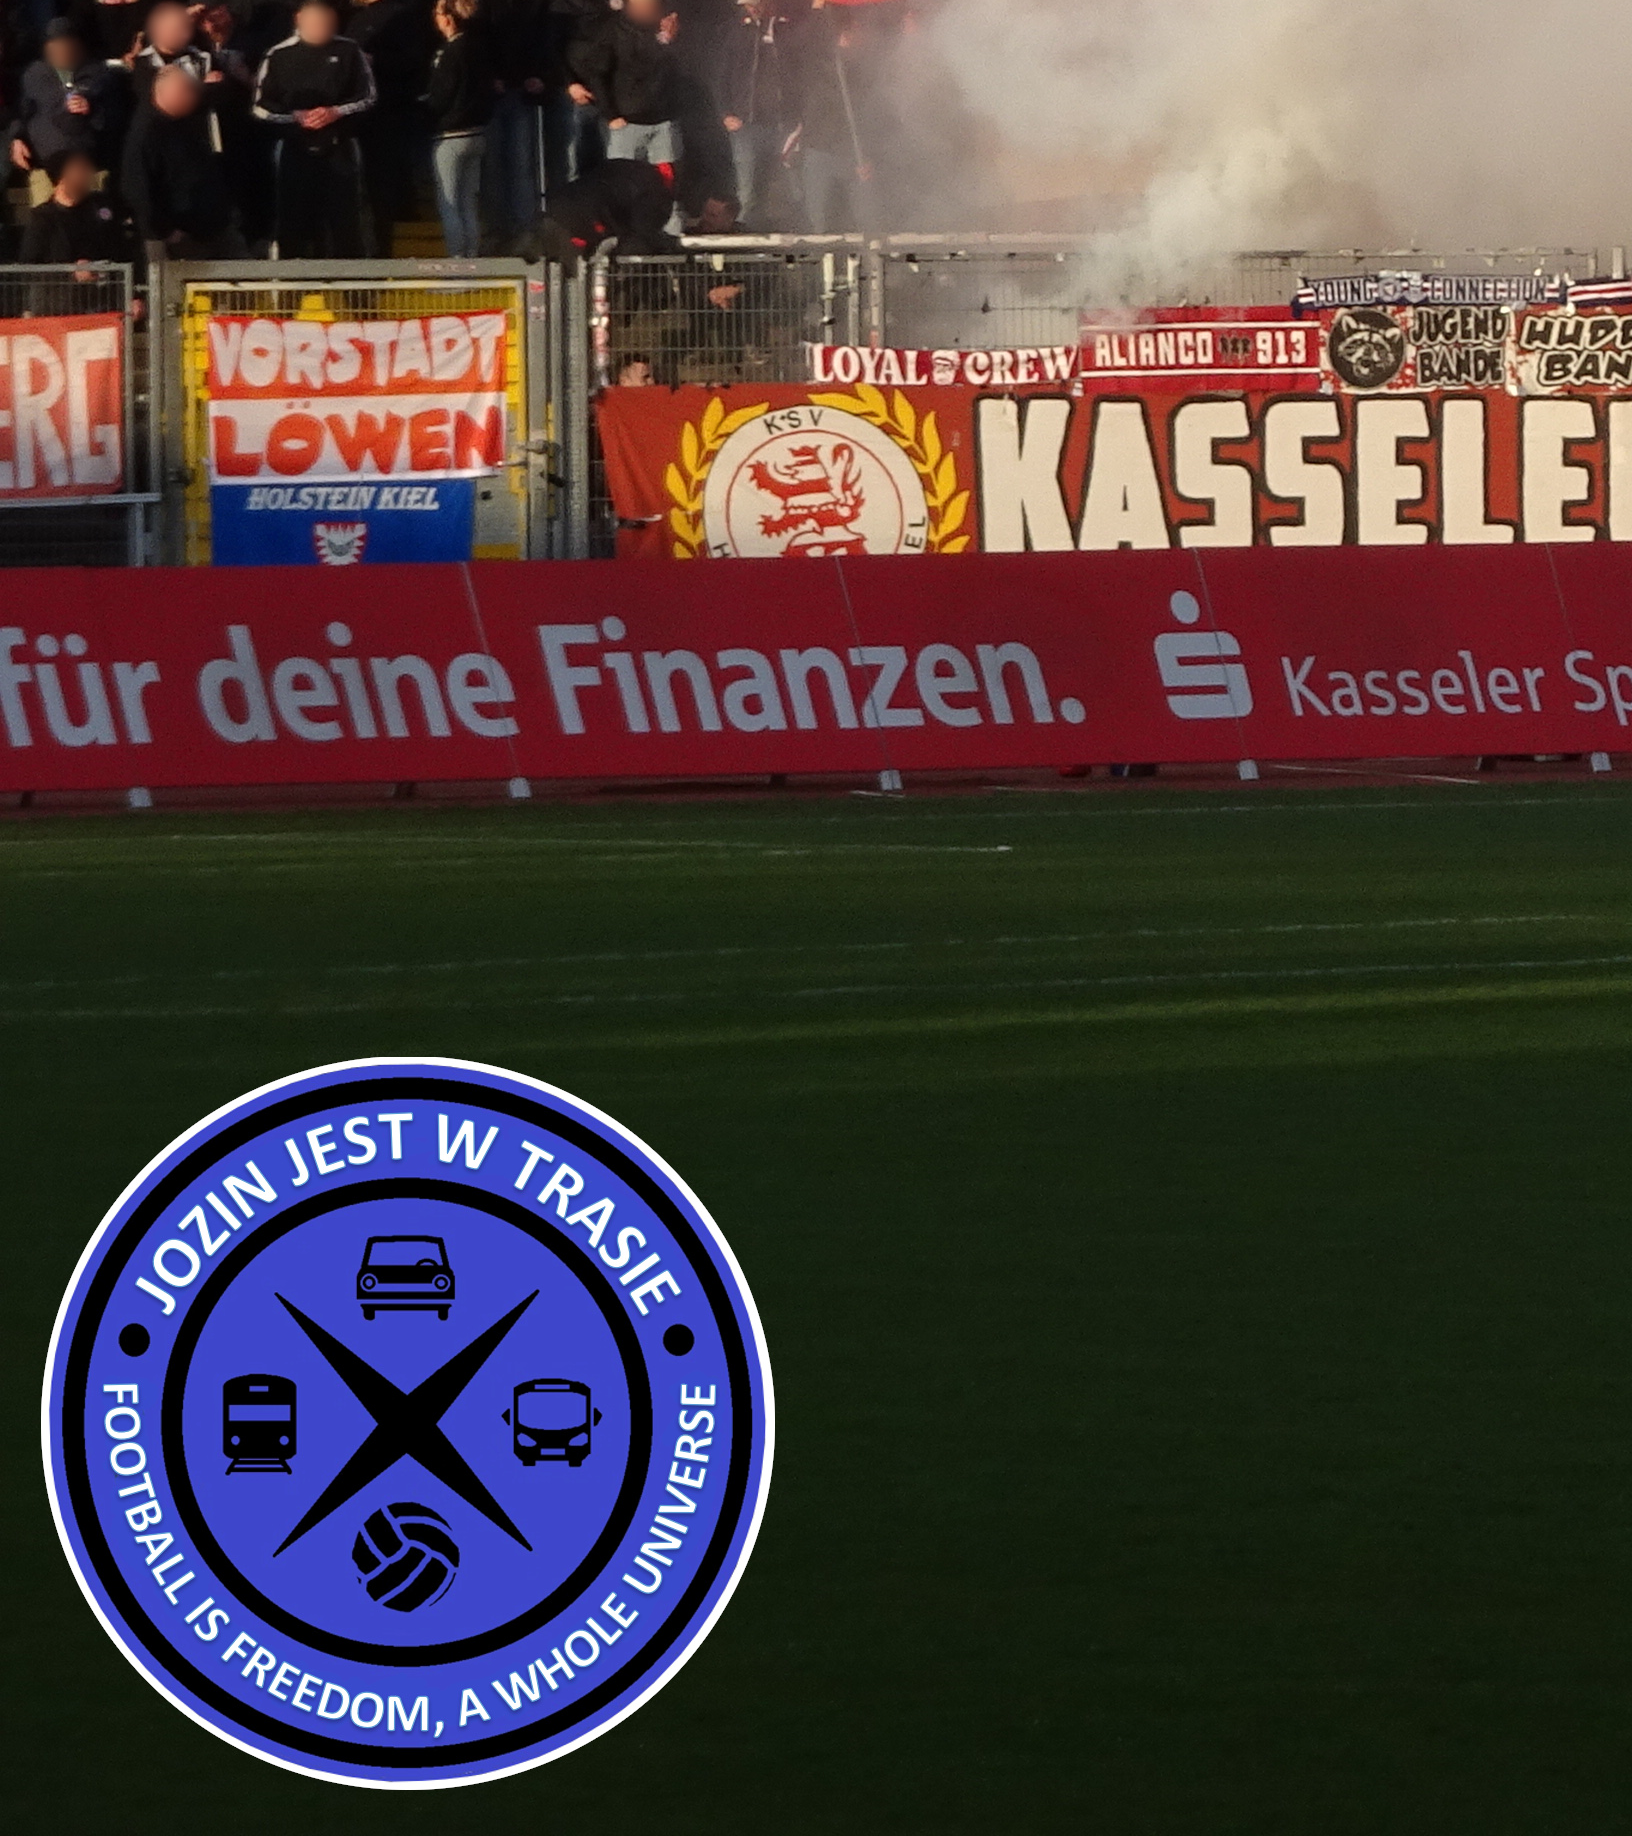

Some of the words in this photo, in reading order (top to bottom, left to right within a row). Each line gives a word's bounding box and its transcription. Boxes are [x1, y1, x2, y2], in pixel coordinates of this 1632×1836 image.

[1309, 276, 1375, 306] YOUNG
[1430, 273, 1548, 304] CONNECTION
[1411, 306, 1510, 345] JUGEND
[209, 311, 504, 389] VORSTADT
[813, 345, 928, 384] LOYAL
[965, 344, 1077, 383] CREW
[1256, 330, 1306, 364] 913
[1416, 346, 1505, 386] BANDE
[214, 401, 504, 476] LÖWEN
[247, 486, 375, 511] HOLSTEIN
[377, 486, 439, 511] KIEL
[0, 627, 161, 749] für
[197, 621, 520, 742] deine
[537, 615, 1086, 736] Finanzen.
[1282, 649, 1544, 718] Kasseler
